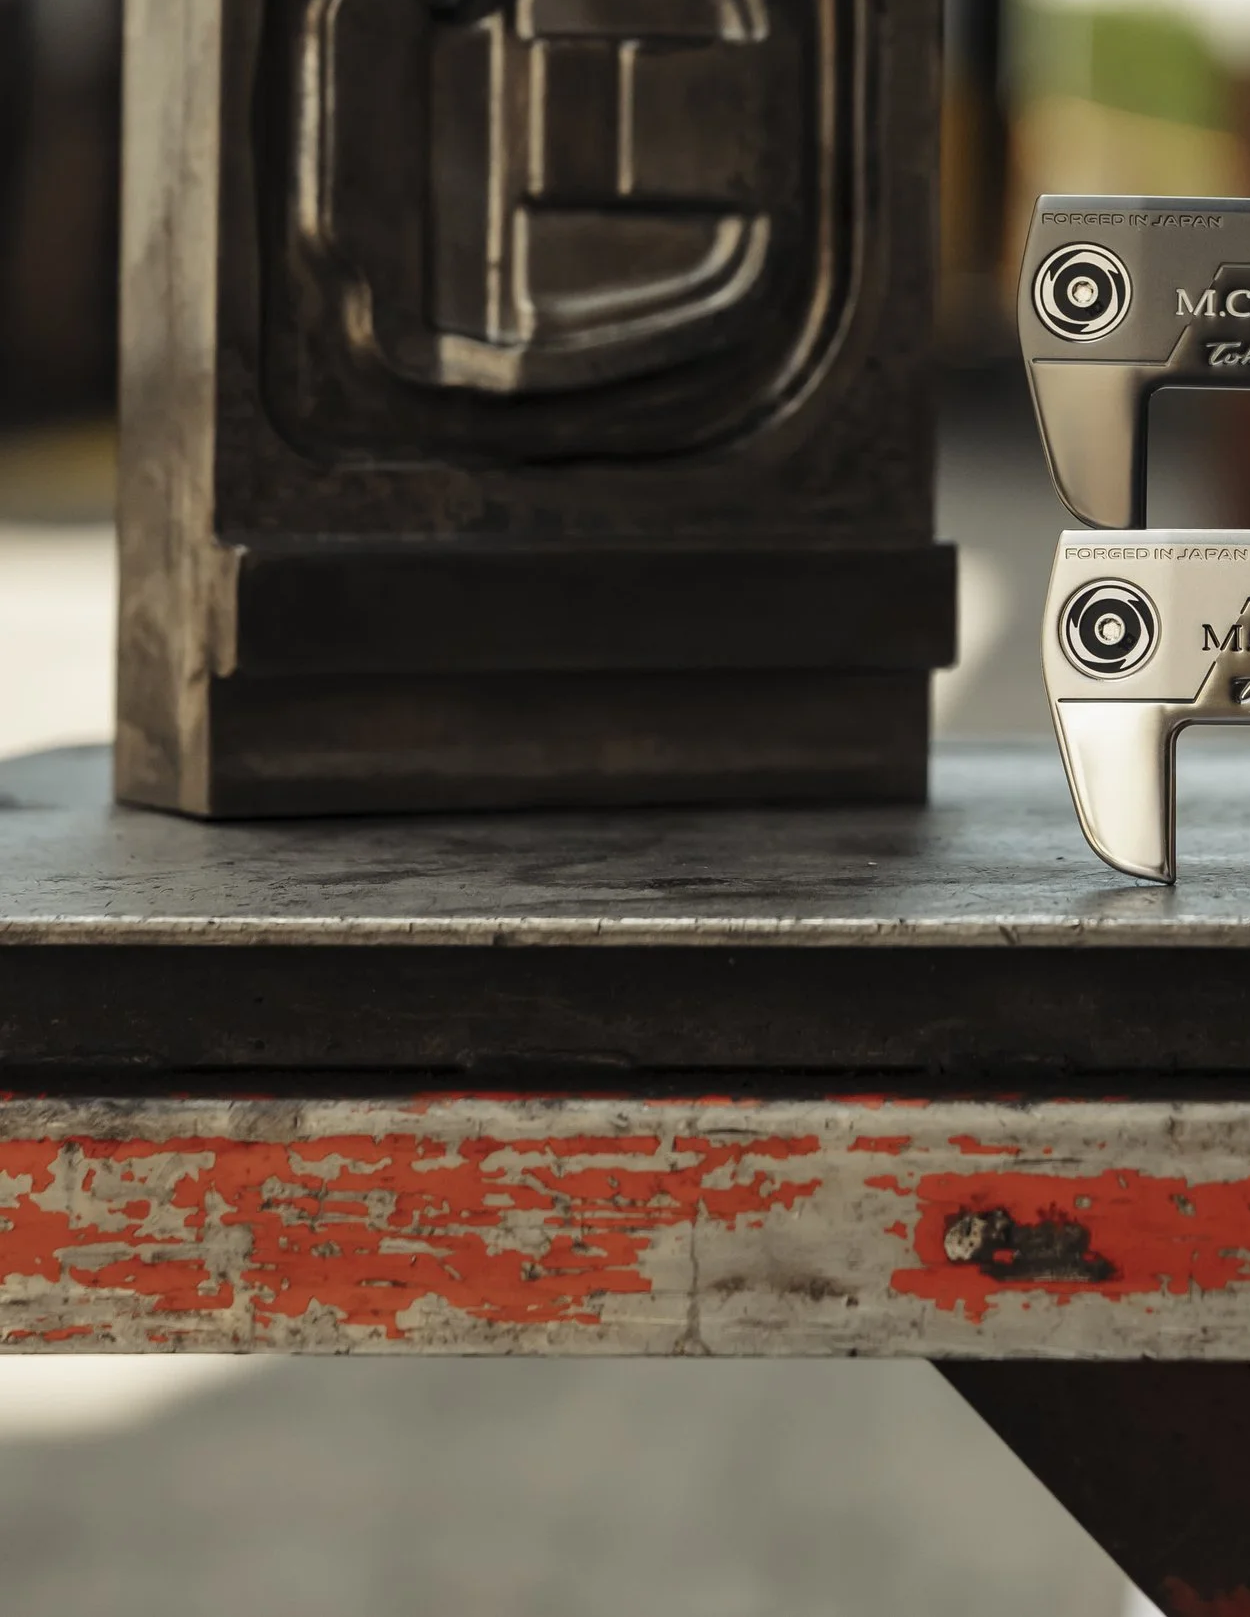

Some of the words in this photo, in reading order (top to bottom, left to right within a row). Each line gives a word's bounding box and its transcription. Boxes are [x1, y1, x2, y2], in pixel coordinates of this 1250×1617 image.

[1041, 212, 1126, 226] FORGED
[1129, 214, 1149, 227] IN
[1151, 214, 1224, 229] JAPAN
[1065, 547, 1150, 561] FORGED
[1153, 548, 1174, 561] IN
[1176, 548, 1249, 562] JAPAN
